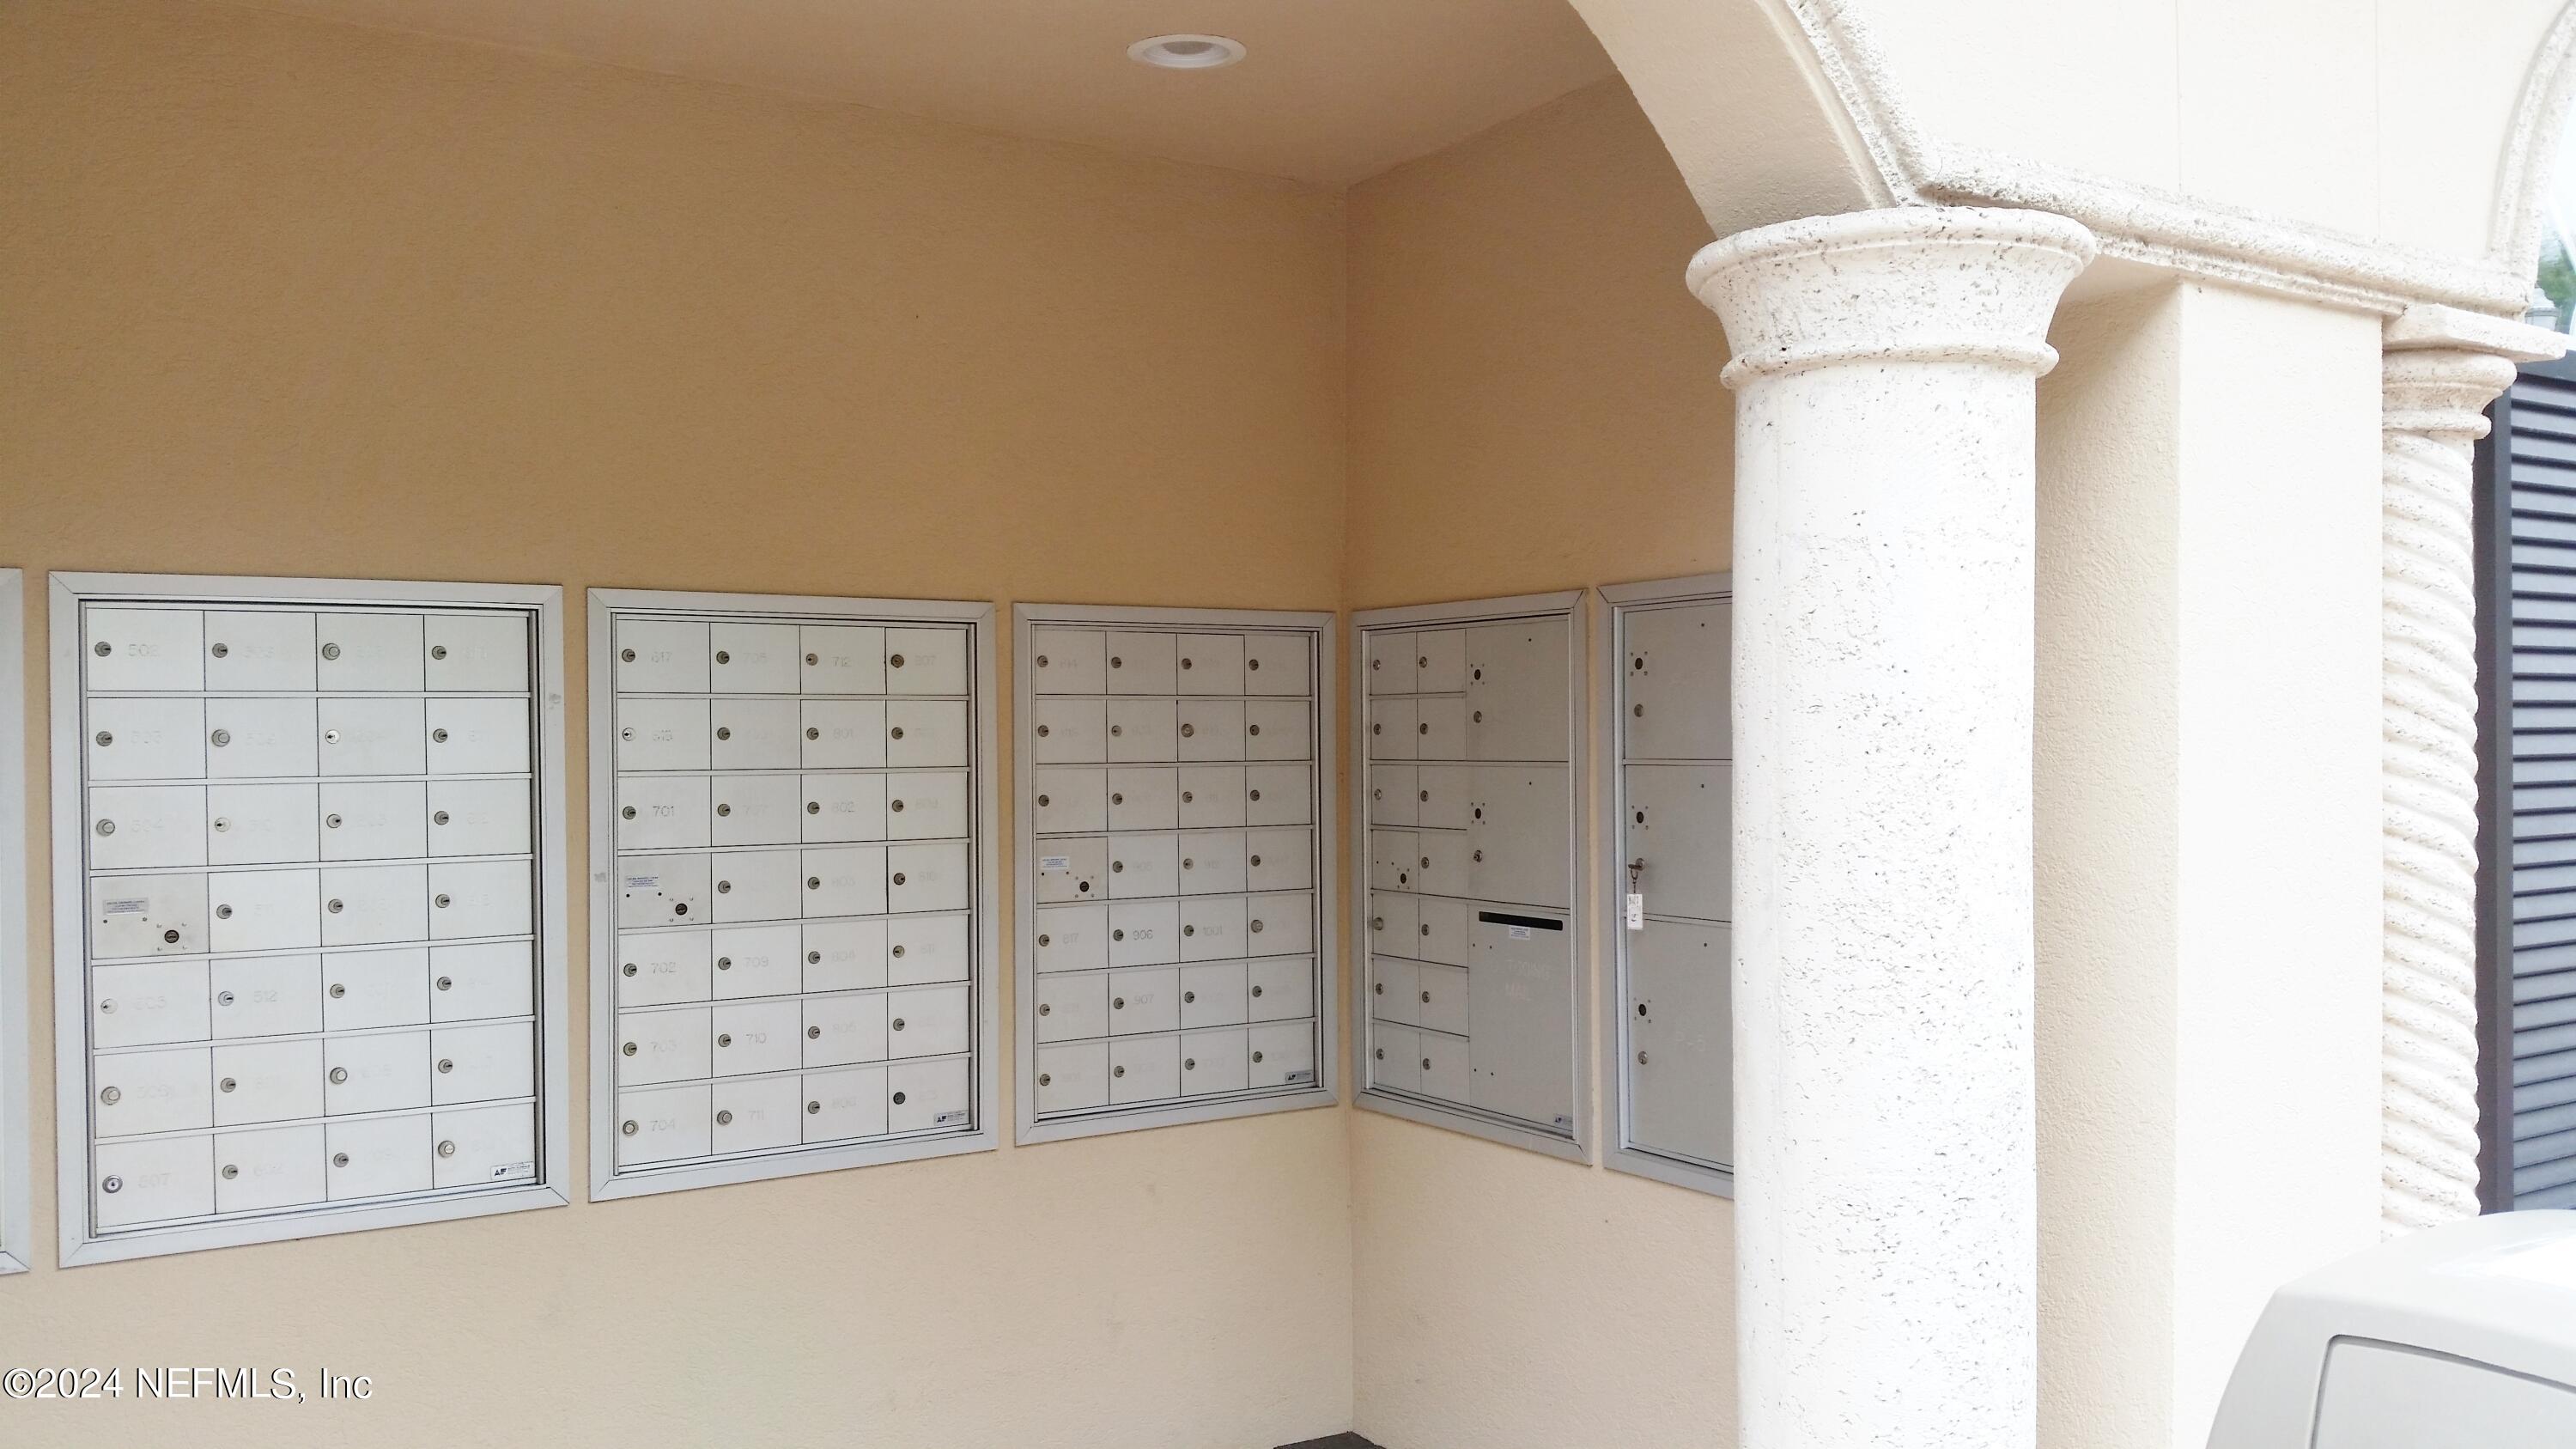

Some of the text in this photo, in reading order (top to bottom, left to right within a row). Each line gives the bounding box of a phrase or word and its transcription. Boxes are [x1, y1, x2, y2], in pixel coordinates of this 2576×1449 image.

[653, 805, 675, 817] 701
[1133, 929, 1153, 941] 906
[650, 961, 677, 974] 702
[744, 956, 769, 968] 709
[1133, 994, 1154, 1005] 907
[745, 1032, 767, 1044] 710
[748, 1110, 764, 1121] 711
[650, 1119, 676, 1132] 704
